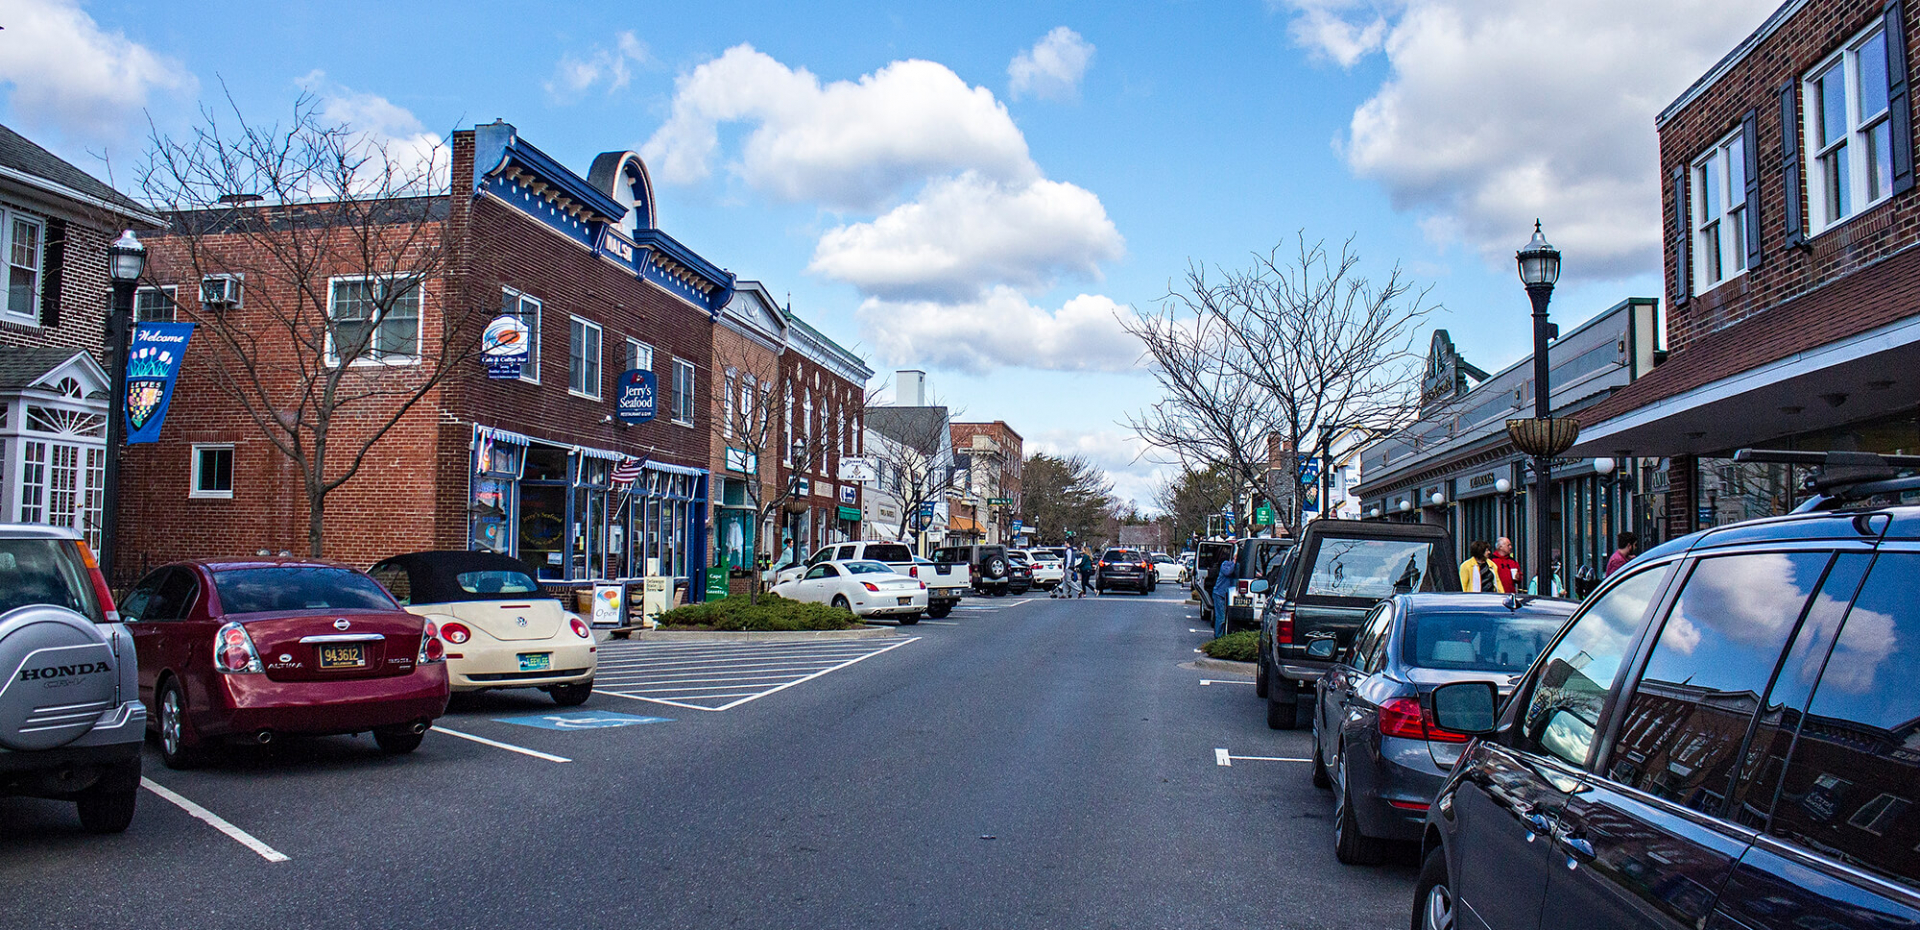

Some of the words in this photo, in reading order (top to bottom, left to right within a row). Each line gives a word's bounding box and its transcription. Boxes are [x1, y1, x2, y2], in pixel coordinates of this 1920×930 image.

[138, 330, 184, 342] Welcome
[130, 381, 162, 389] LEWES
[624, 384, 652, 399] Jerry's
[620, 397, 653, 408] Seafood
[596, 609, 617, 618] Open
[324, 649, 359, 661] 943612
[20, 661, 111, 681] HONDA
[267, 662, 304, 670] ALTIMA
